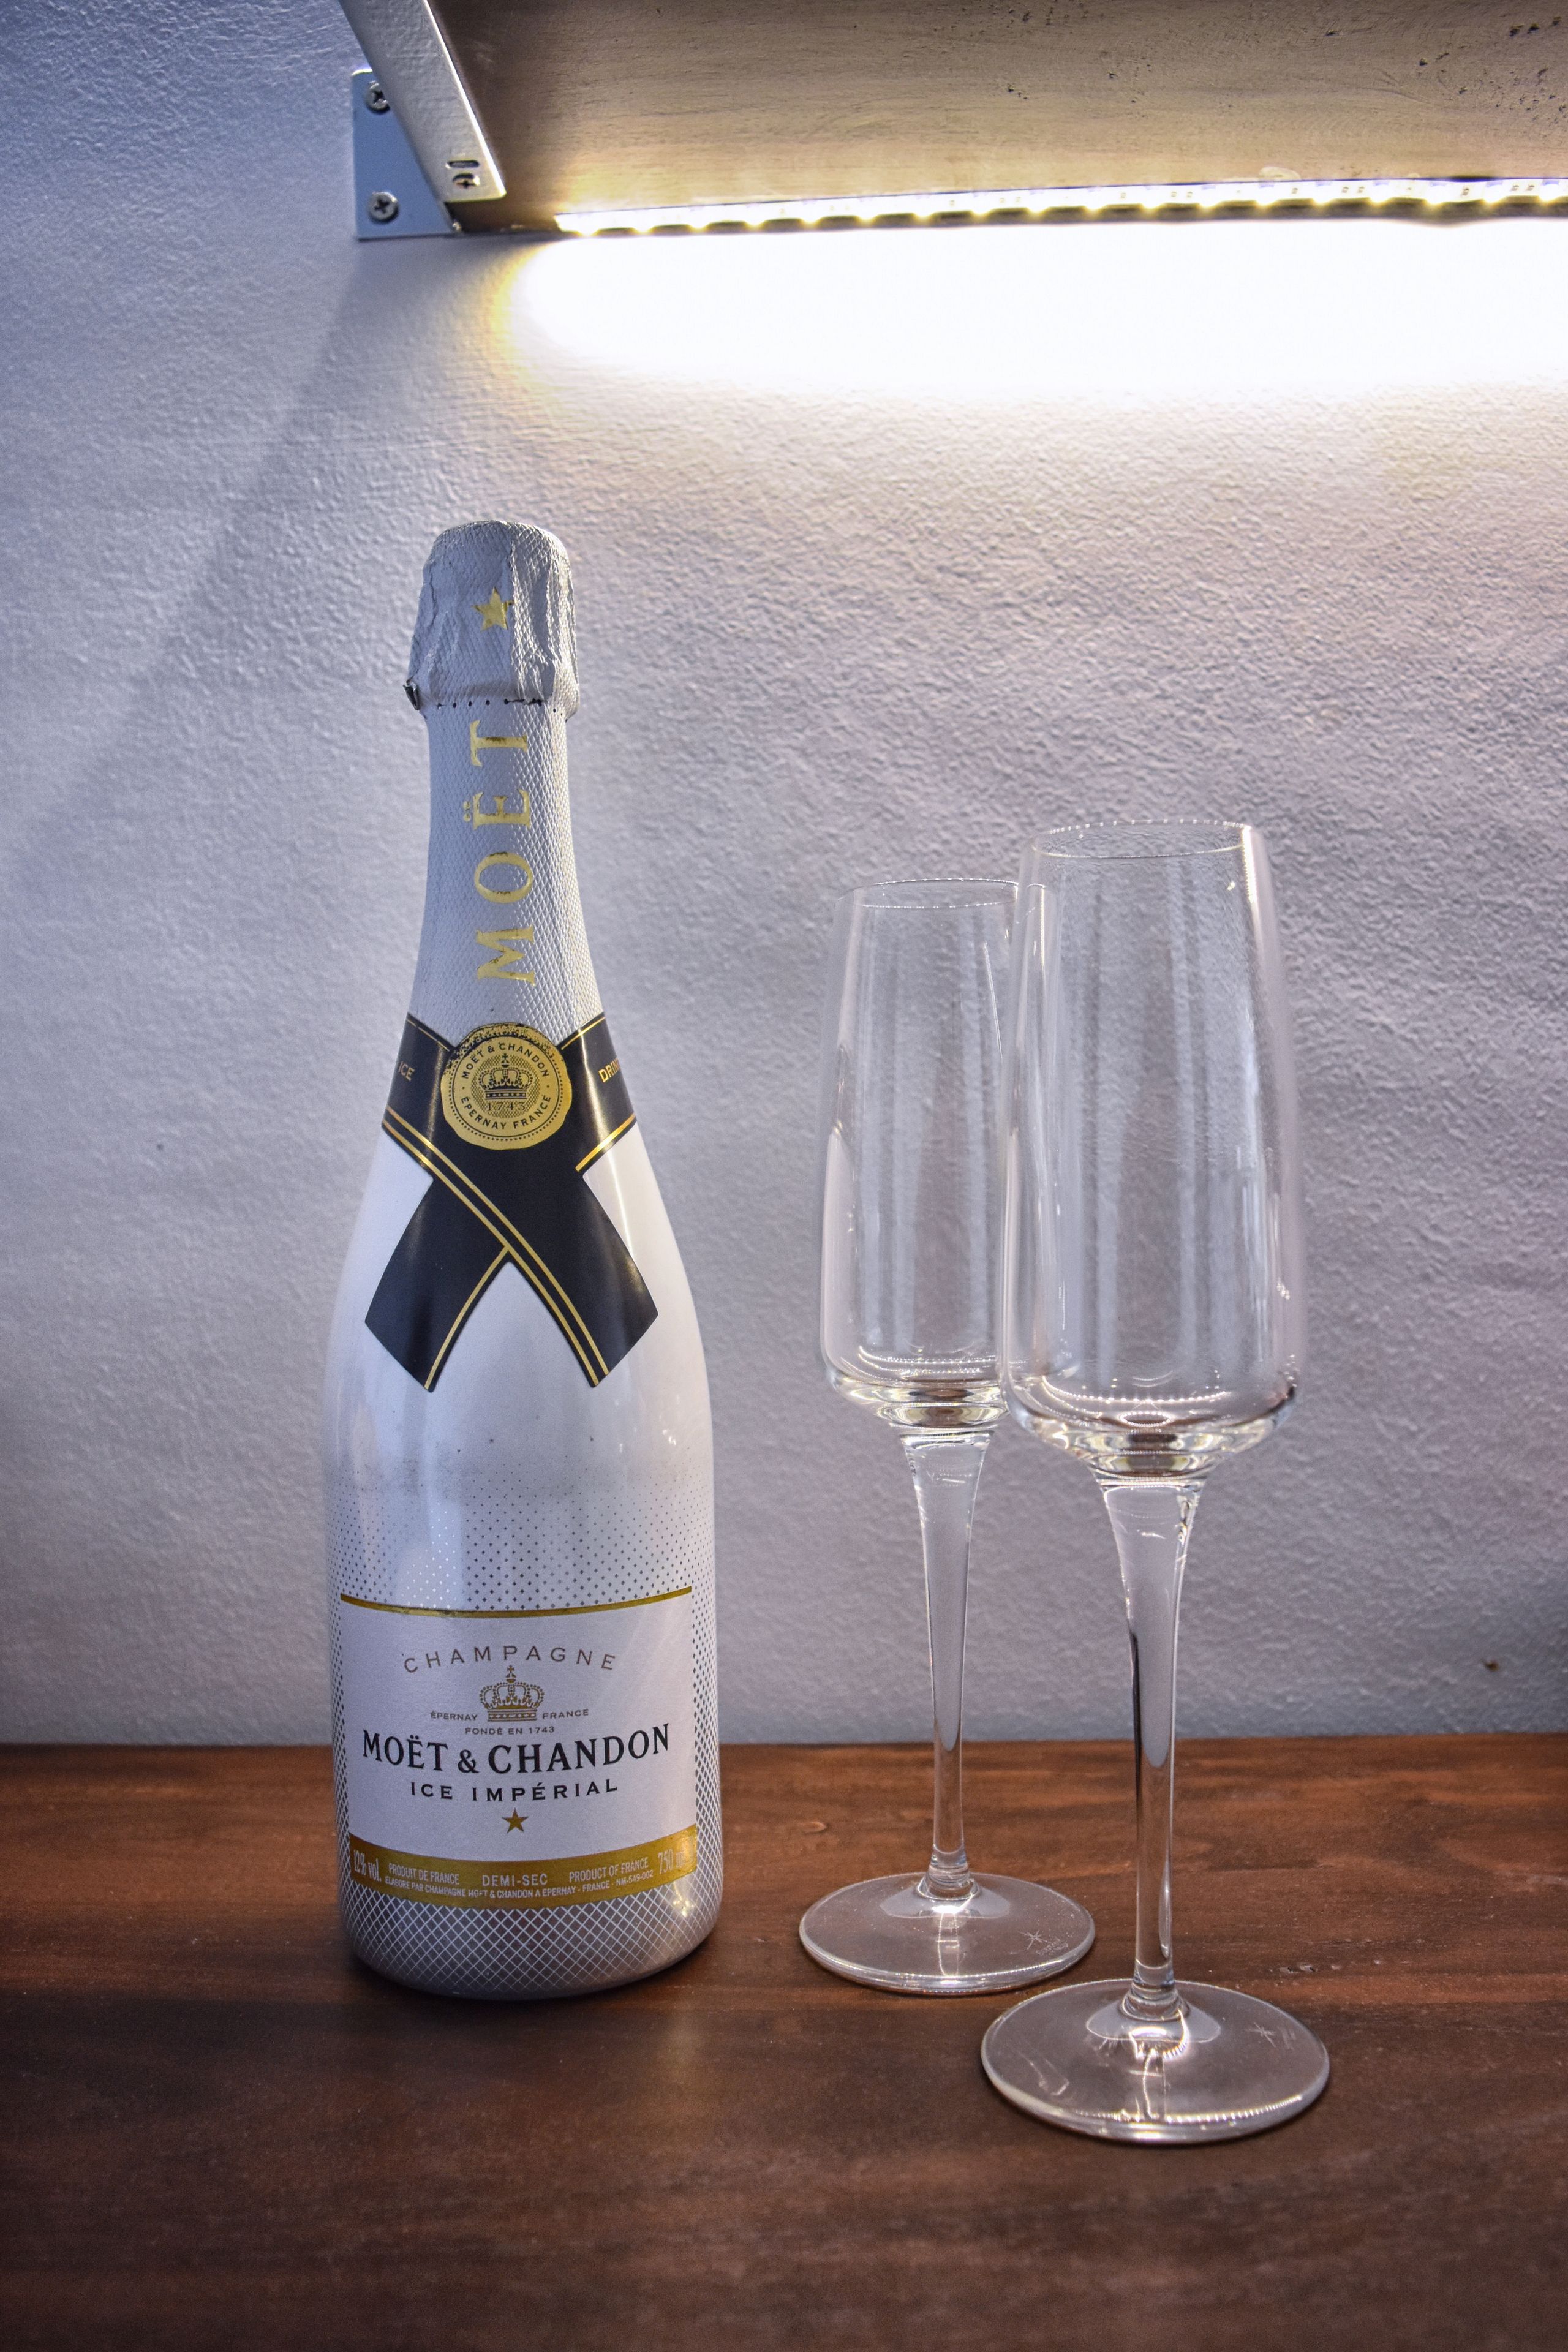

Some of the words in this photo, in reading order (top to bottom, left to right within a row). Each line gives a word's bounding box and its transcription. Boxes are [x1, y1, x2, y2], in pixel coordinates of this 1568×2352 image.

[463, 720, 535, 986] MOËT
[398, 1060, 415, 1082] ICE
[461, 1049, 484, 1079] MOËT
[499, 1042, 549, 1077] CHANDON
[461, 1096, 507, 1130] ÉPERNAY
[513, 1095, 551, 1129] FRANCE
[487, 1102, 526, 1111] 1743
[404, 1645, 616, 1673] CHAMPAGNE
[431, 1710, 478, 1721] ÉPERNAY
[542, 1709, 589, 1720] FRANCE
[465, 1726, 503, 1735] FONDÉ
[529, 1725, 554, 1734] 1743
[363, 1729, 448, 1771] MOËT
[458, 1749, 480, 1774] &
[488, 1723, 669, 1774] CHANDON
[410, 1781, 453, 1800] ICE
[472, 1778, 619, 1802] IMPÉRIAL
[569, 1866, 606, 1883] PRODUCT
[609, 1864, 619, 1877] OF
[621, 1857, 649, 1874] FRANCE
[657, 1849, 674, 1874] 750
[388, 1863, 417, 1879] PRODUIT
[418, 1869, 428, 1881] DE
[431, 1871, 460, 1885] FRANCE
[482, 1873, 548, 1887] DEMI-SEC
[425, 1885, 466, 1897] CHAMPAGNE
[490, 1890, 496, 1899] &
[497, 1889, 533, 1899] CHANDON
[582, 1880, 610, 1893] FRANCE
